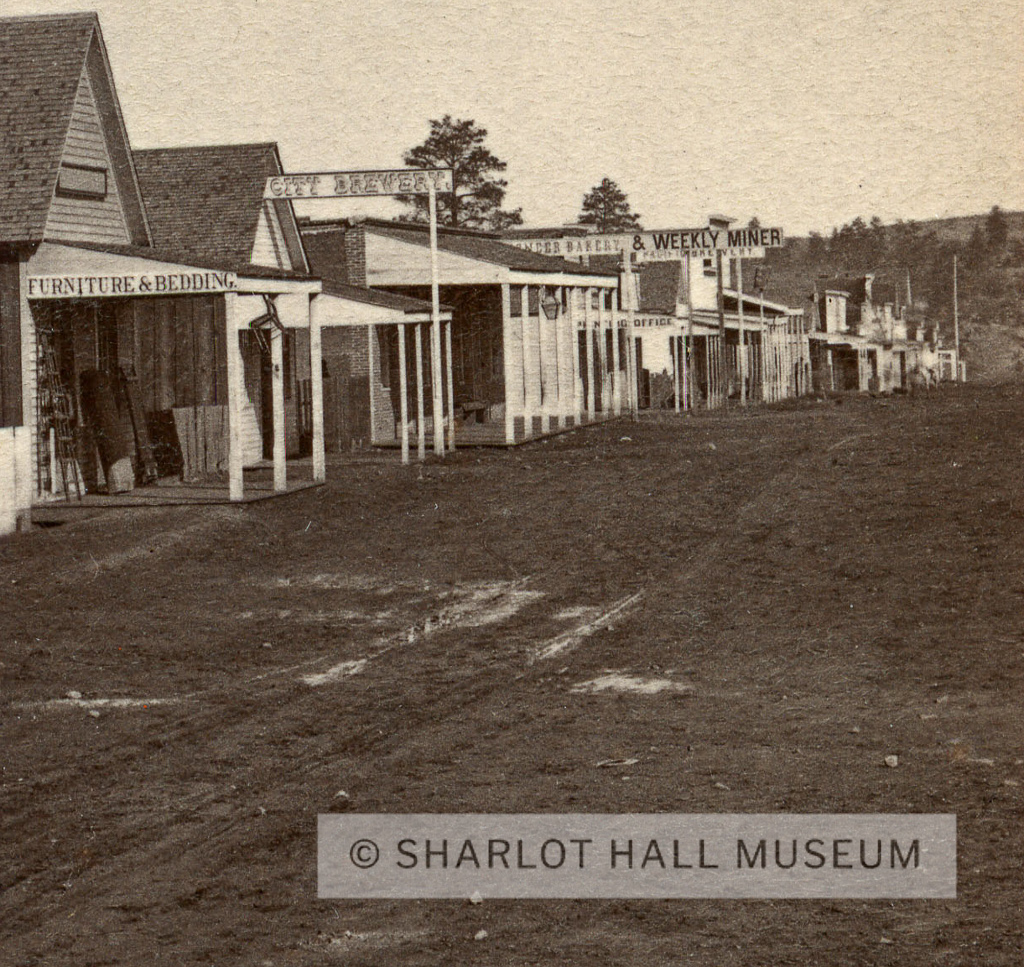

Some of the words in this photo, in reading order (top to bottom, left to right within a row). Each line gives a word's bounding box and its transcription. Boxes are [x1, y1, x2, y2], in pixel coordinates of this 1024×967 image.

[270, 176, 321, 197] CITY
[567, 239, 621, 253] BAKERY
[632, 235, 646, 250] &
[653, 232, 719, 250] WEEKLY
[728, 228, 782, 247] MINER
[28, 275, 136, 295] FURNITURE
[138, 275, 152, 292] &
[634, 317, 672, 328] OFFICE
